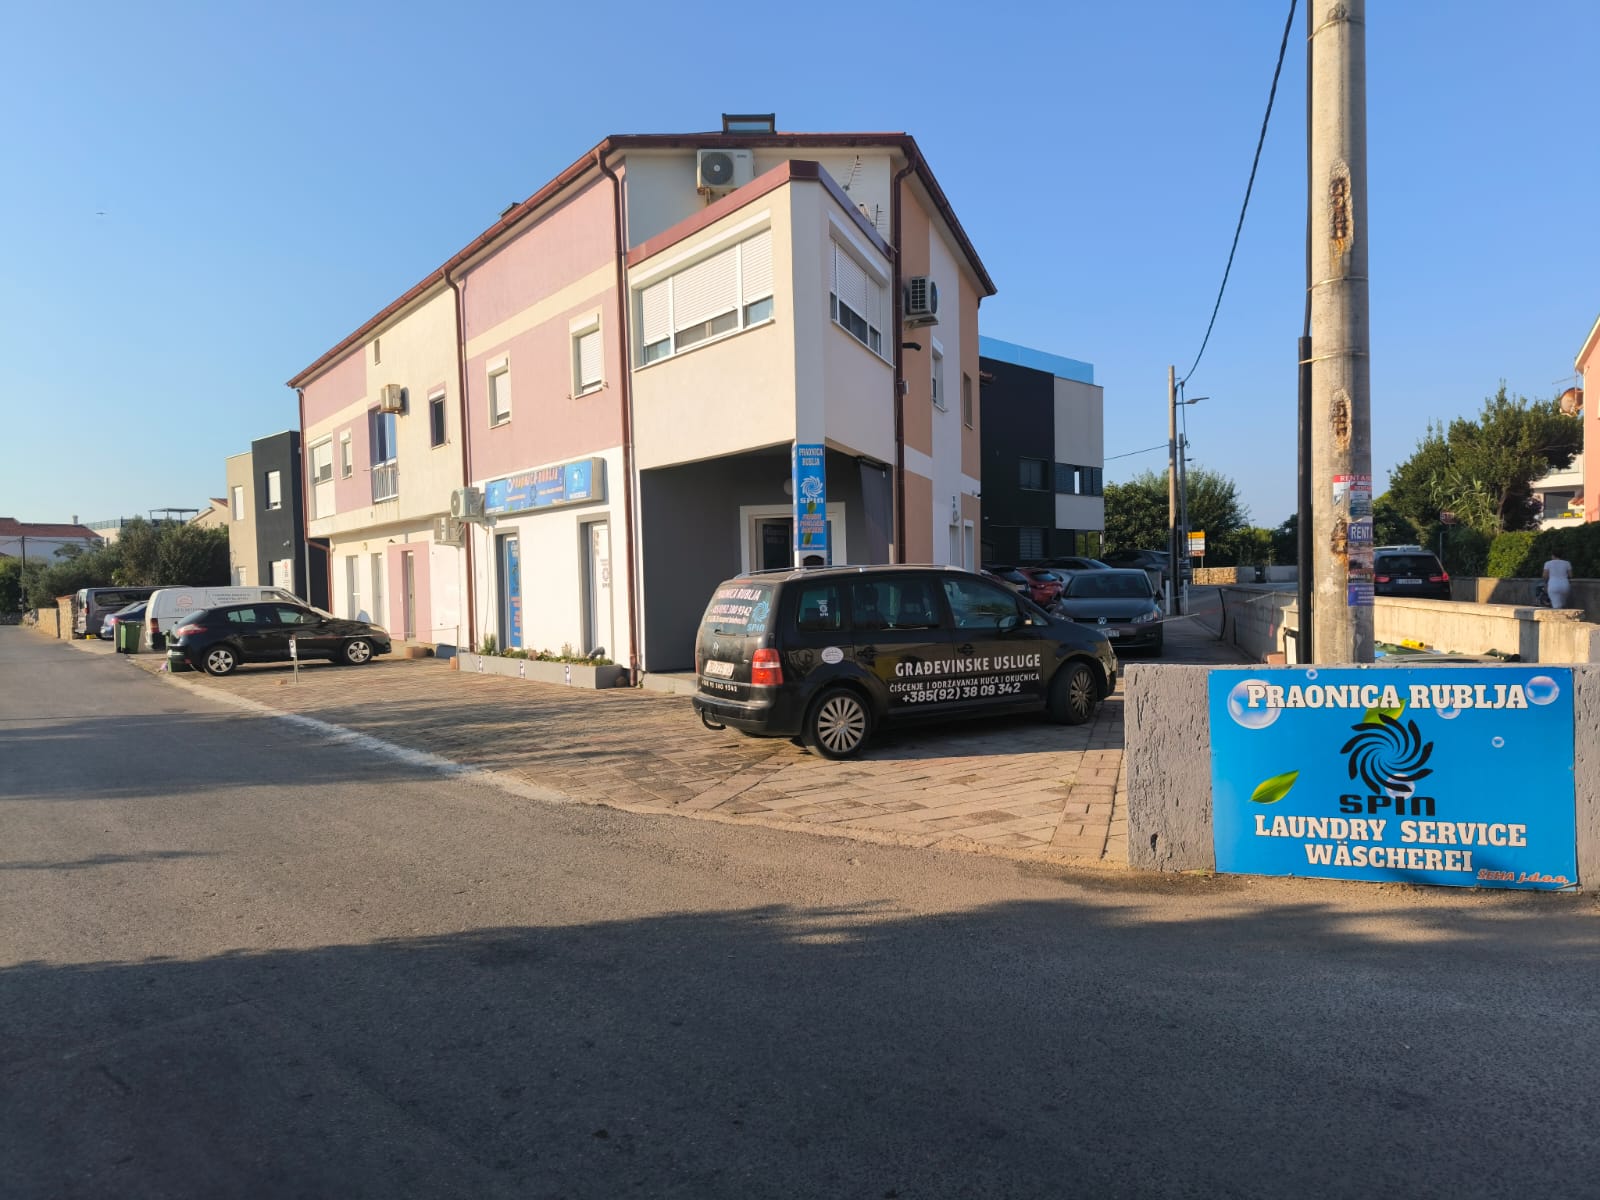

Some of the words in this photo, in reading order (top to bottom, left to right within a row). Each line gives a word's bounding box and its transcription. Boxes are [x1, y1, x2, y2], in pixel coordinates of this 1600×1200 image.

[1351, 526, 1370, 540] RENT
[895, 658, 990, 677] GRAĐEVINSKE
[994, 654, 1040, 670] USLUGE
[902, 687, 961, 703] +385(92)
[962, 686, 978, 698] 38
[980, 684, 996, 696] 09
[997, 682, 1021, 694] 342
[1247, 684, 1399, 709] PRAONICA
[1409, 684, 1528, 709] RUBLJA
[1339, 794, 1436, 816] SPIN
[1255, 814, 1386, 840] LAUNDRY
[1400, 821, 1527, 847] SERVICE
[1305, 839, 1473, 872] WÄSCHEREI
